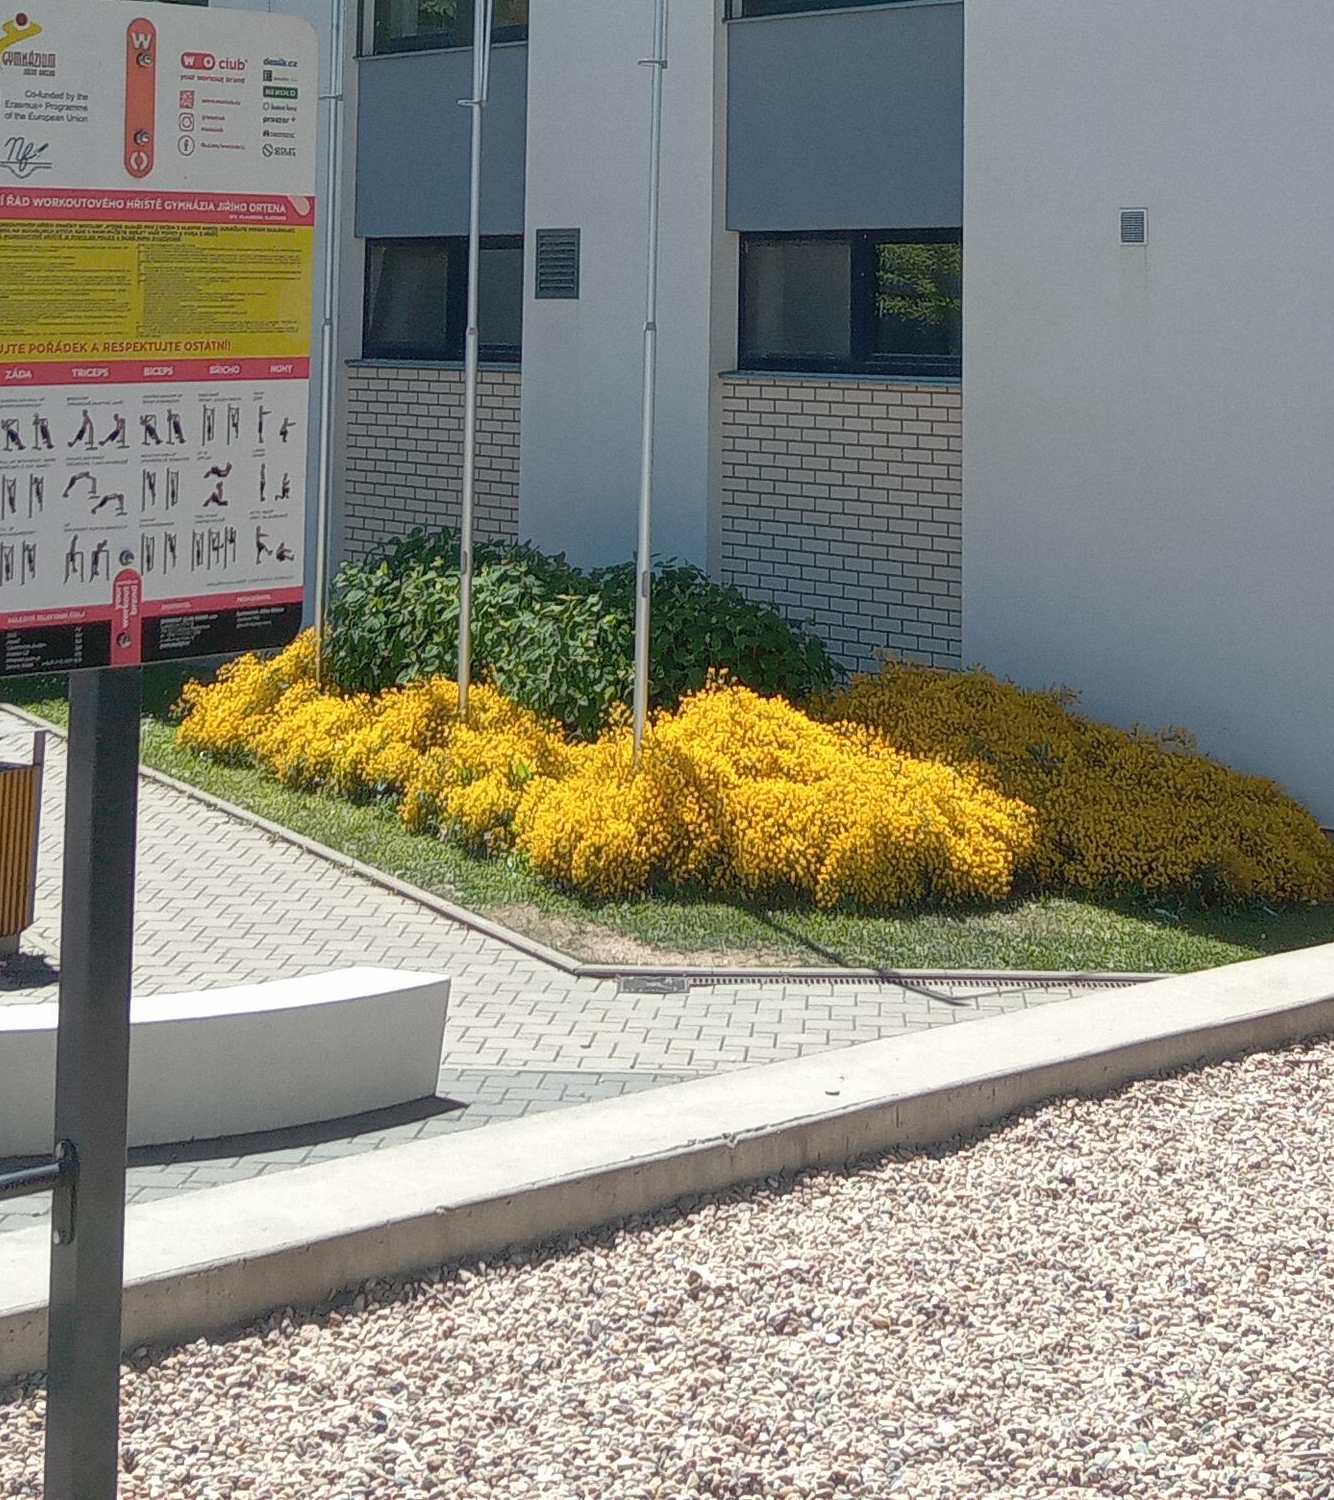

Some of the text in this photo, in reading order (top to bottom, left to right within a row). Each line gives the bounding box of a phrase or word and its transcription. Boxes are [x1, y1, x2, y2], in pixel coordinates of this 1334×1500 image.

[25, 90, 64, 100] Co-funded
[45, 102, 89, 112] Programme
[28, 112, 65, 122] European
[67, 114, 89, 122] Union
[6, 194, 29, 206] ŘÁD
[33, 196, 124, 210] WORKOUTOVÉHO
[164, 198, 215, 212] GYMNÁZIA
[249, 202, 286, 213] ORTENA
[28, 340, 87, 354] POŘÁDEK
[91, 342, 100, 353] A
[103, 340, 180, 353] RESPEKTUJTE
[184, 338, 231, 351] OSTATNÍ!
[4, 367, 33, 380] ZÁDA
[71, 367, 109, 378] TRICEPS
